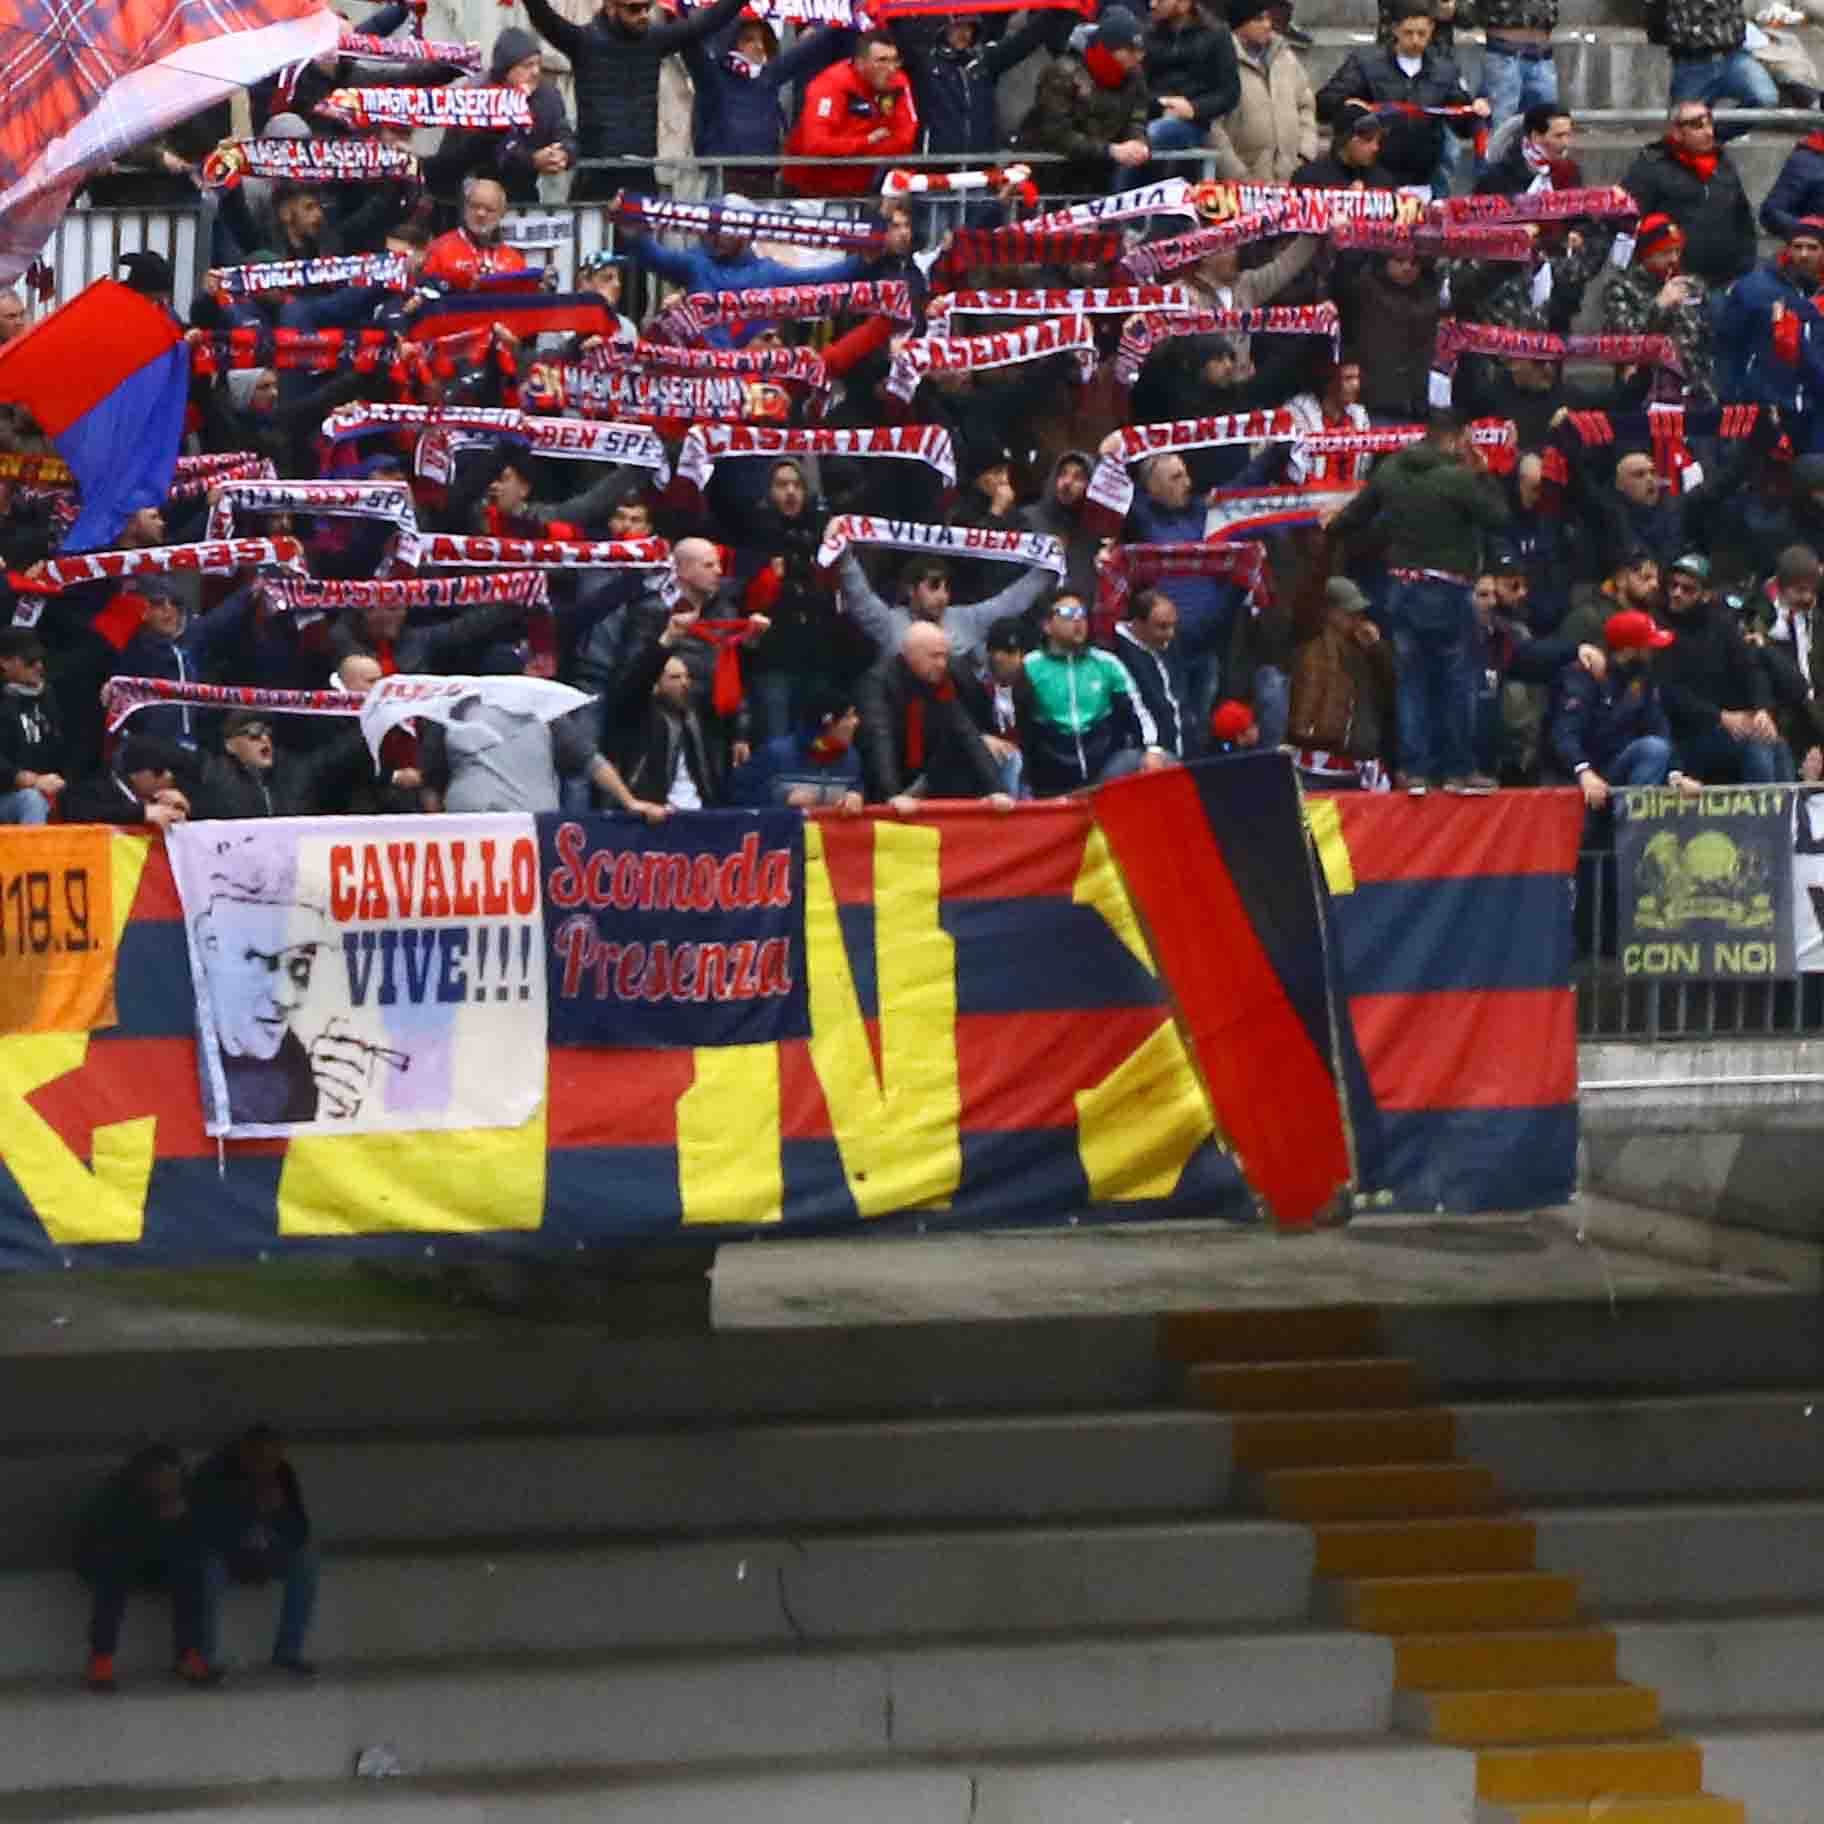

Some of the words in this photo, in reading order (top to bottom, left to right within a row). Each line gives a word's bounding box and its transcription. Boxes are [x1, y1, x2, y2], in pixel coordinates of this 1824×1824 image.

[329, 833, 536, 922] CAVALLO
[550, 821, 792, 912] Scomoda
[348, 926, 535, 1008] VIVE!!!
[553, 917, 793, 1004] Presenza
[1623, 942, 1701, 976] CON
[1713, 941, 1778, 973] NOI
